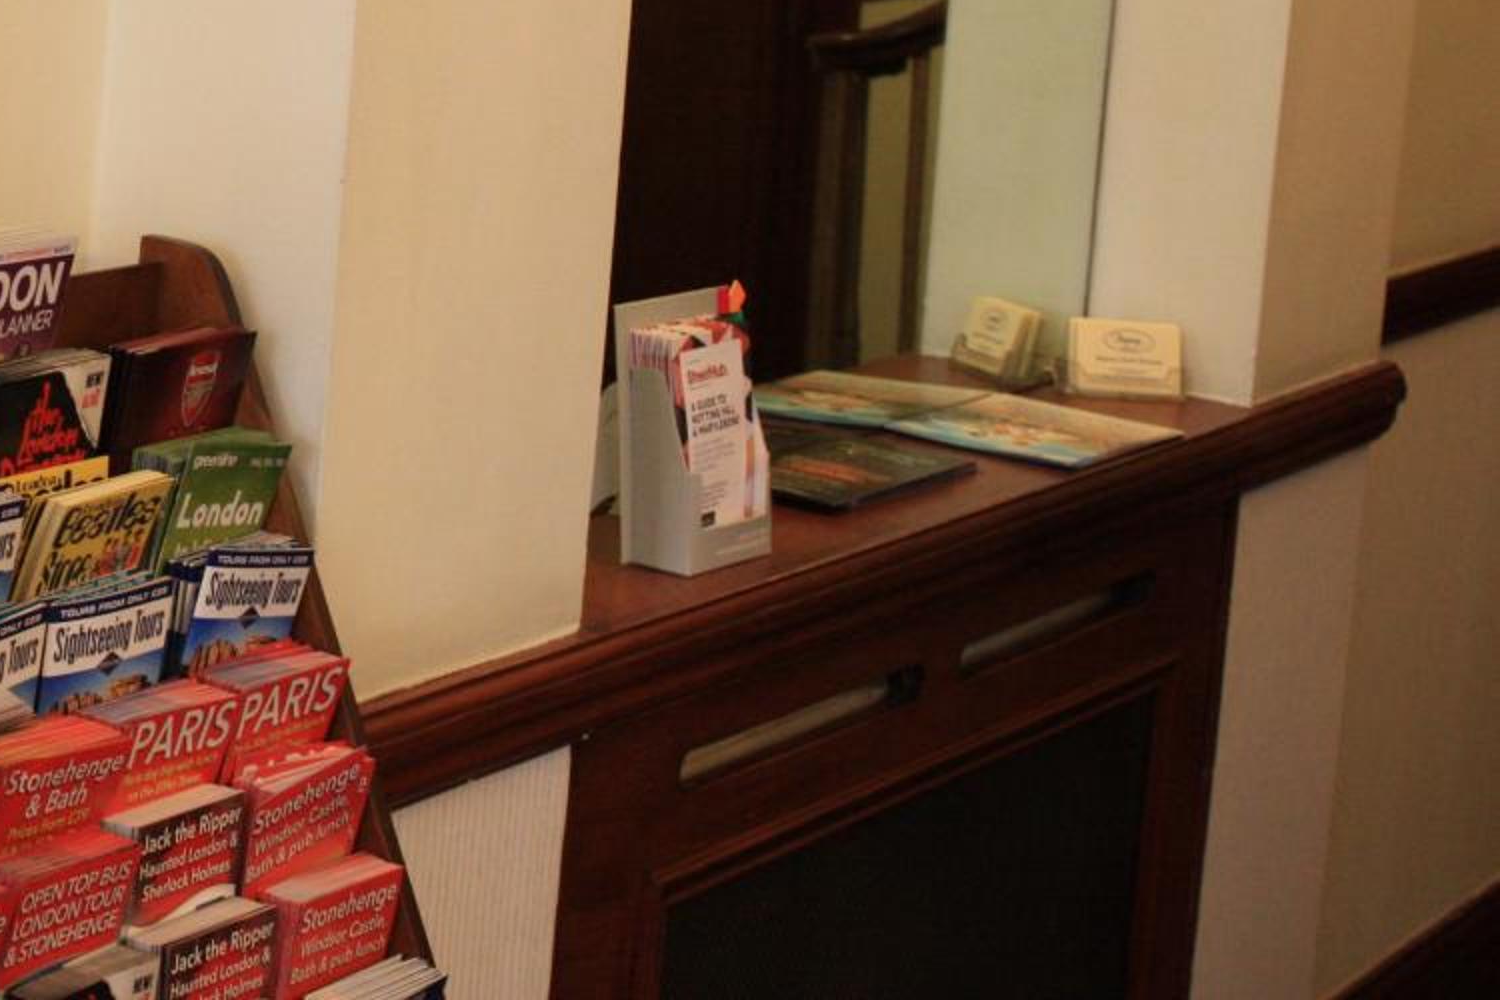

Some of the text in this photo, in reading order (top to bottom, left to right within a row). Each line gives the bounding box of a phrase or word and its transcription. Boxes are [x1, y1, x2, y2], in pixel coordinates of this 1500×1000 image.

[176, 489, 264, 528] London
[206, 571, 302, 610] Sightseeing Tours
[7, 638, 39, 674] Tours
[54, 609, 165, 665] Sightseeing Tours
[236, 666, 343, 740] PARIS
[126, 701, 237, 769] PARIS
[3, 754, 125, 796] Stonehenge
[251, 763, 361, 836] Stonehenge
[25, 782, 88, 819] & Bath
[142, 807, 242, 856] Jack the Ripper
[140, 848, 187, 879] Haunted
[188, 839, 228, 862] London
[21, 860, 133, 914] OPEN TOP BUS
[301, 884, 398, 934] Stonehenge
[3, 908, 117, 969] & STONEHENGE
[11, 884, 127, 943] LONDON TOUR
[171, 922, 275, 975] Jack the Ripper
[170, 965, 218, 1000] Haunted
[219, 953, 260, 981] London
